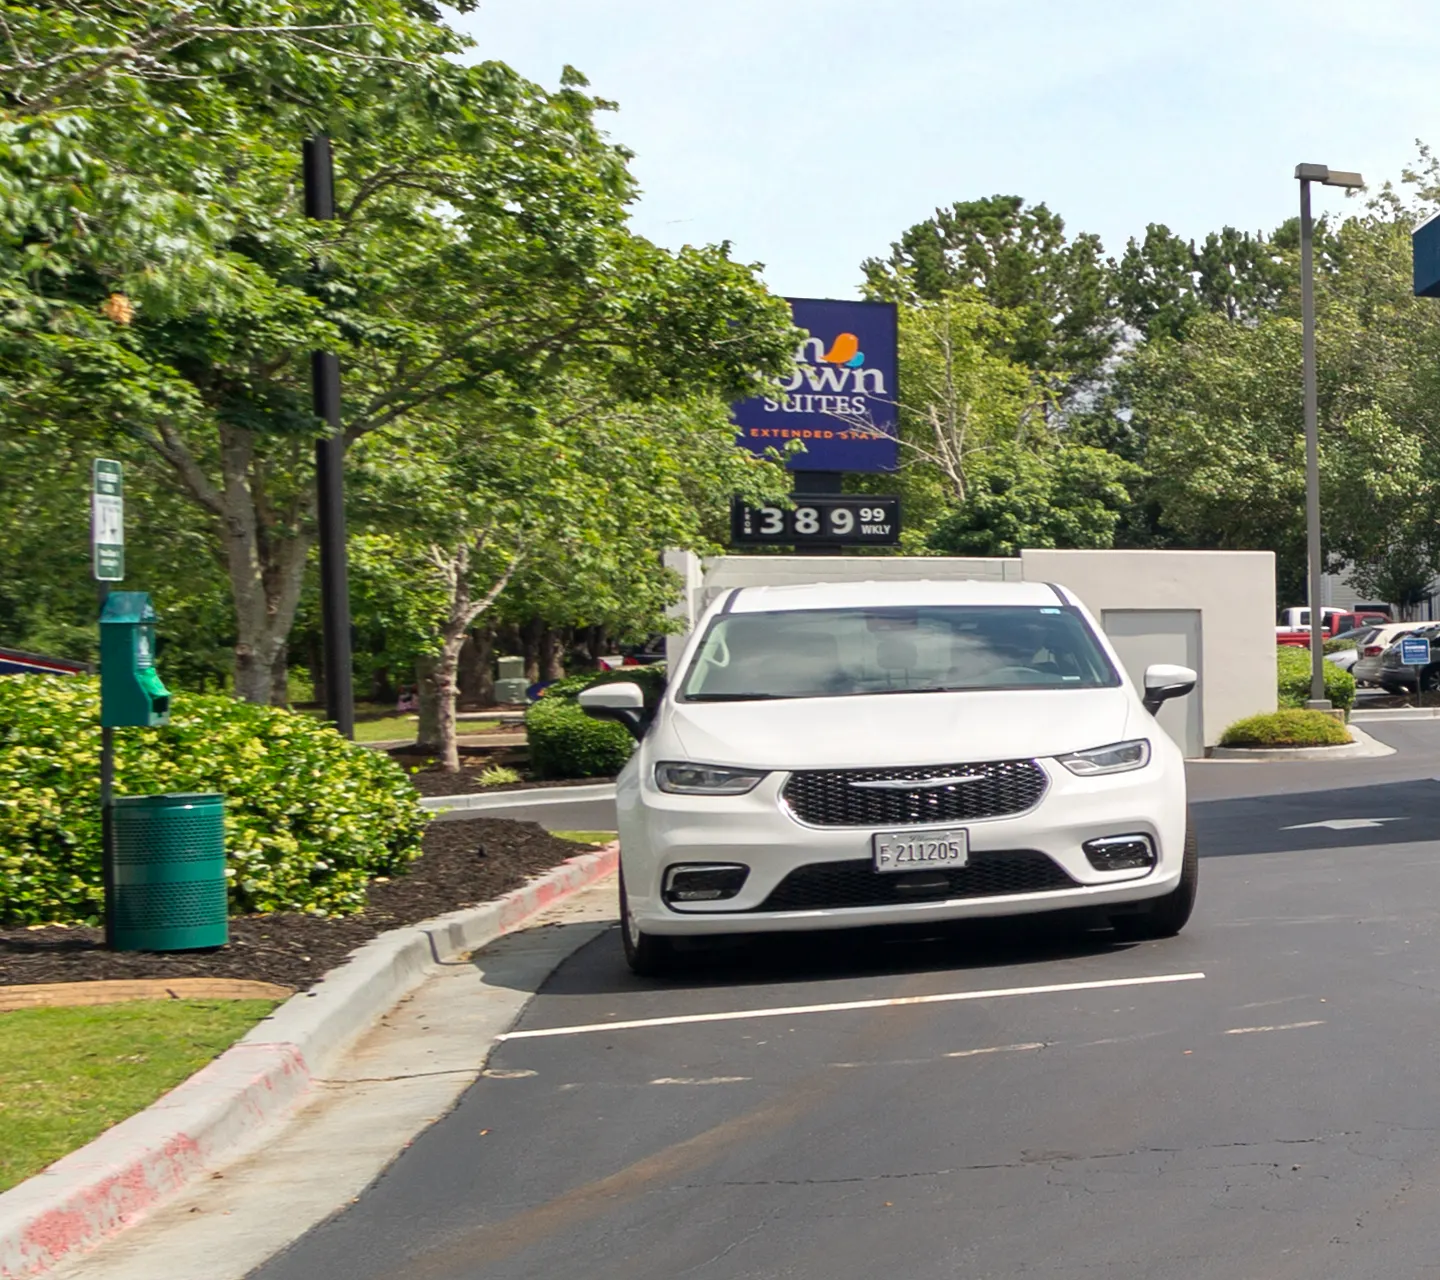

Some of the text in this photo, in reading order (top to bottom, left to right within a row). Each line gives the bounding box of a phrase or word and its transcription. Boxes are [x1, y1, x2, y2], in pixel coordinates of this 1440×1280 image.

[762, 366, 888, 394] own
[750, 428, 834, 440] EXTENDED
[859, 508, 886, 522] 99
[861, 524, 891, 535] WKLY
[896, 841, 959, 862] 211205
